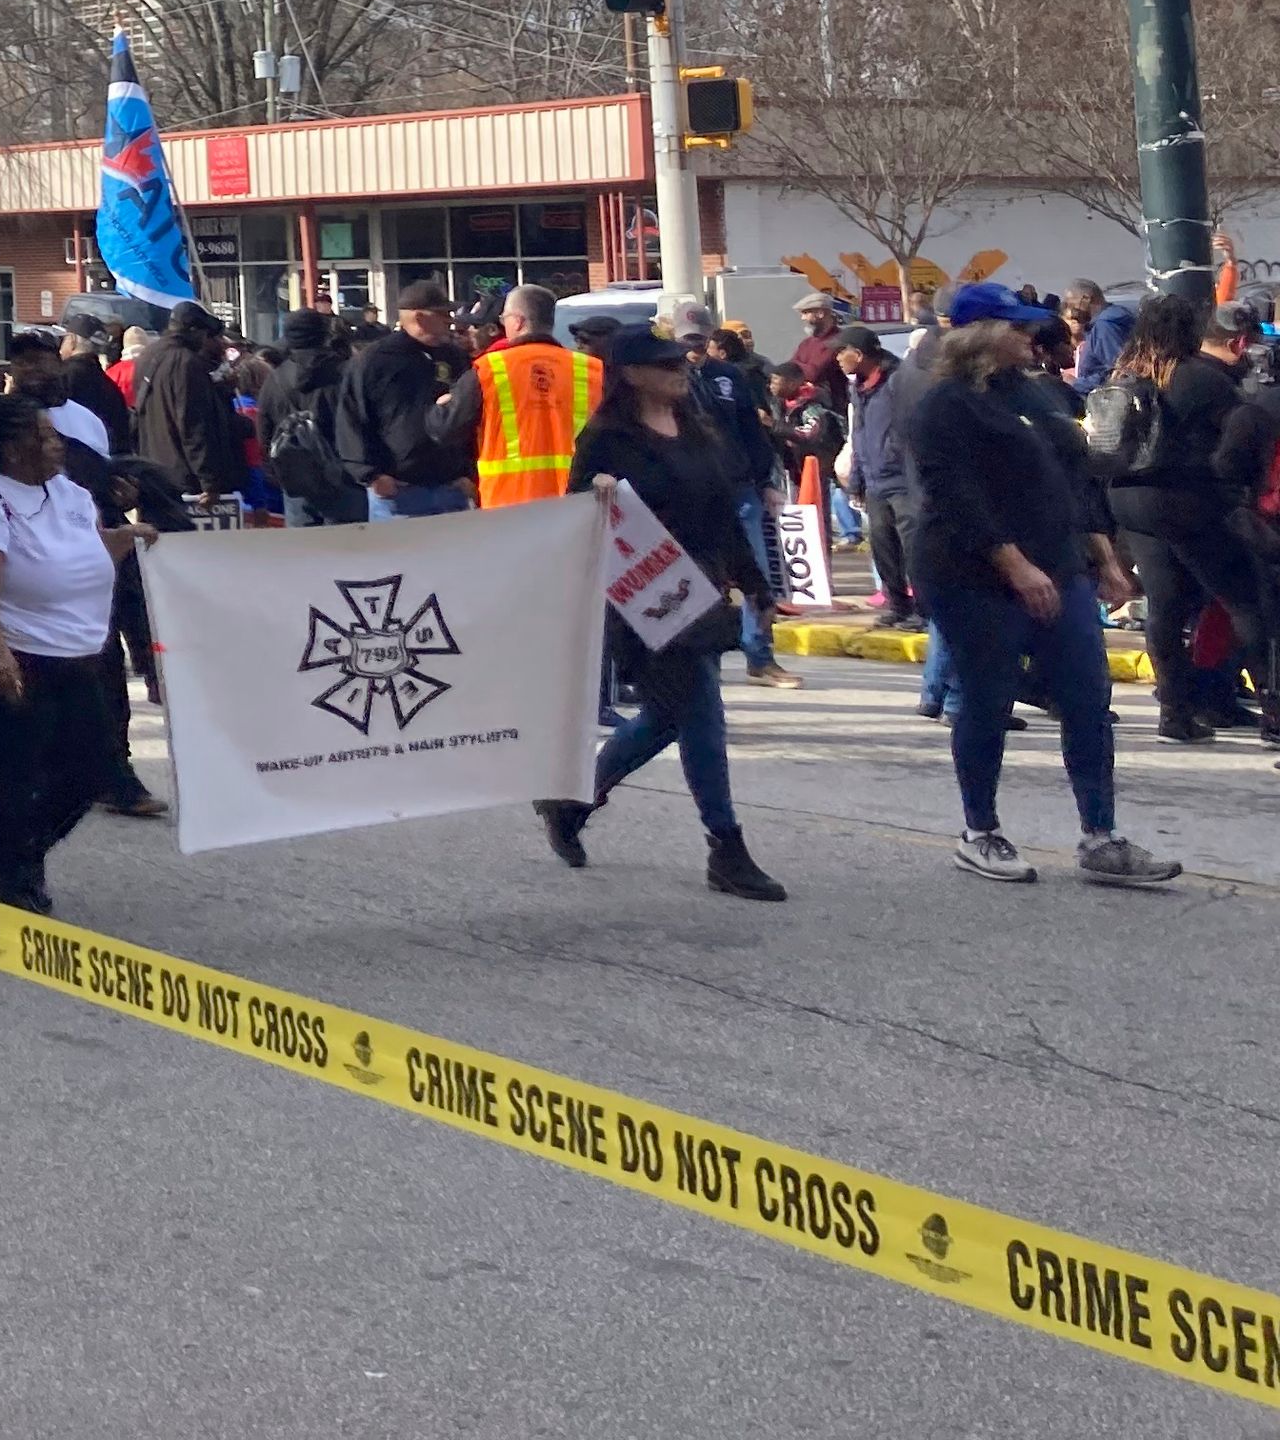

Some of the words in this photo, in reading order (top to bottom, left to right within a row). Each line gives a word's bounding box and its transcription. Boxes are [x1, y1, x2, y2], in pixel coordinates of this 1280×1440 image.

[780, 510, 804, 532] YO
[785, 537, 816, 601] SOY
[364, 596, 380, 614] T
[415, 627, 434, 643] S
[394, 743, 404, 754] &
[409, 738, 444, 752] HAIR
[21, 925, 83, 987] CRIME
[88, 947, 155, 1012] SCENE
[161, 971, 191, 1022] DO
[198, 981, 242, 1039] NOT
[248, 993, 330, 1068] CROSS
[407, 1047, 499, 1129] CRIME
[509, 1083, 609, 1164] SCENE
[618, 1111, 664, 1183] DO
[673, 1130, 742, 1209] NOT
[754, 1156, 882, 1257] CROSS
[1005, 1238, 1153, 1351] CRIME
[1168, 1287, 1280, 1389] SCEN
